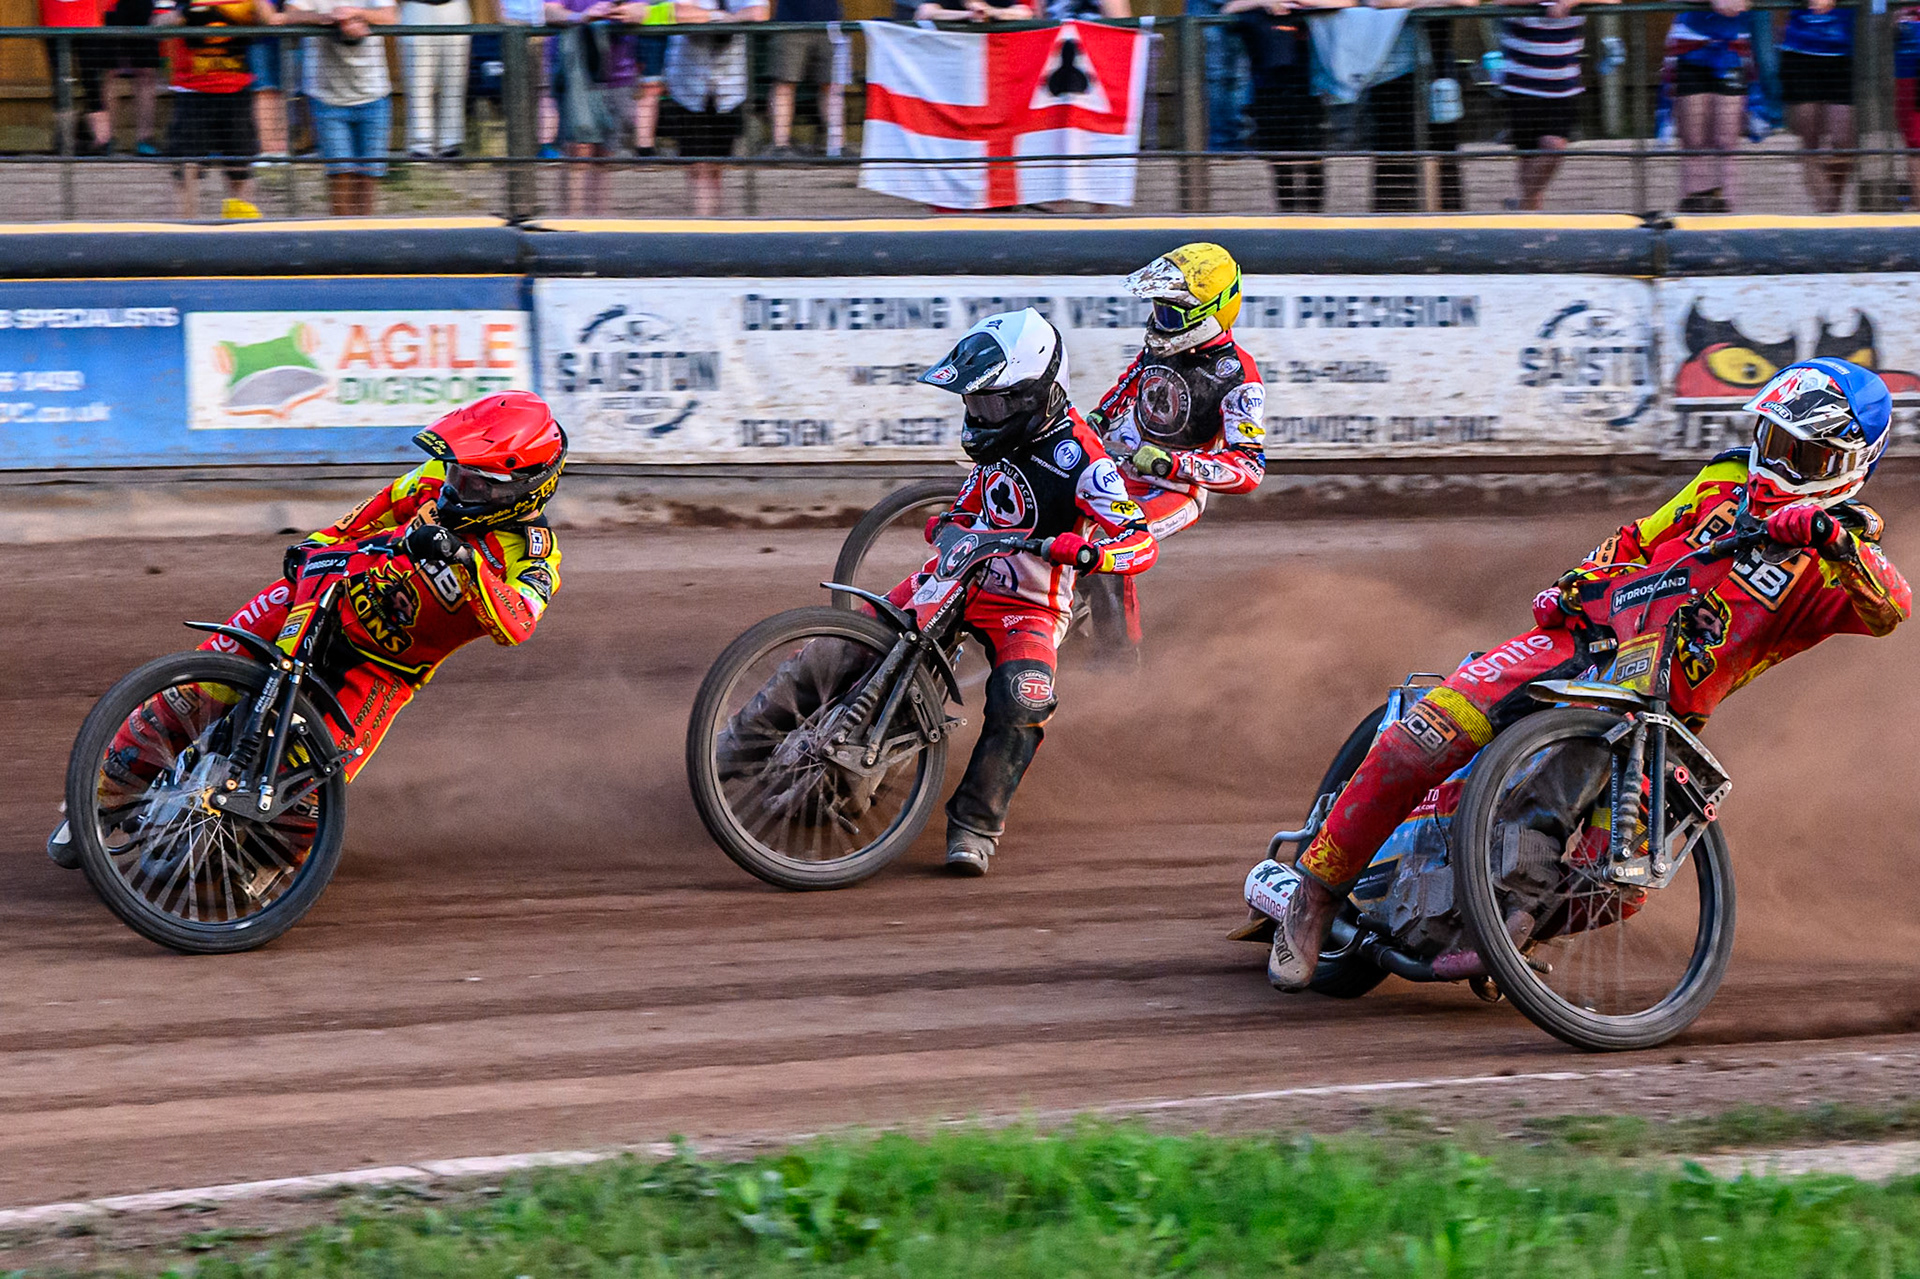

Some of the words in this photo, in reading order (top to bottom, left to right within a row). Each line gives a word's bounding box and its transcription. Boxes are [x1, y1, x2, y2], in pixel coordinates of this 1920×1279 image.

[742, 294, 950, 330] DELIVERING
[1294, 297, 1479, 328] PRECISION
[337, 323, 518, 369] AGILE
[1765, 401, 1791, 420] SHOEI
[740, 418, 833, 447] DESIGN
[1018, 483, 1035, 510] ACES
[530, 528, 544, 556] JCB
[348, 582, 406, 654] IONS
[1460, 634, 1555, 684] ignite
[1617, 659, 1648, 680] JCB
[1020, 681, 1050, 697] STS
[1400, 713, 1444, 750] JCB
